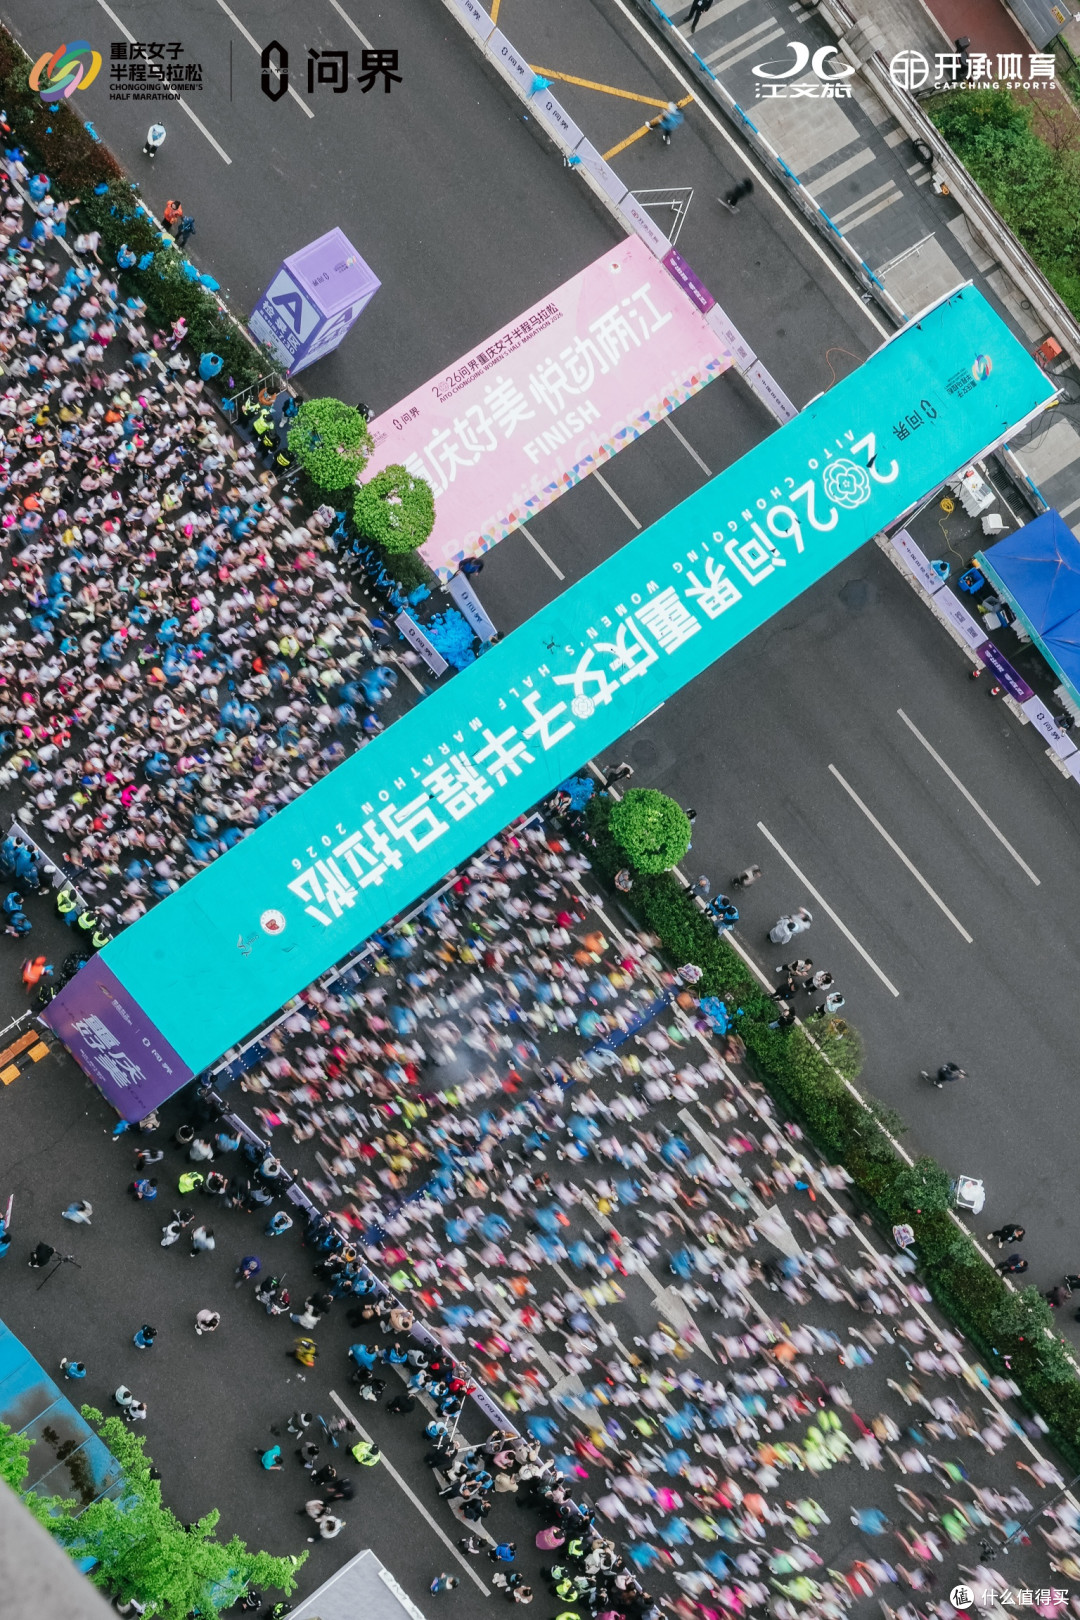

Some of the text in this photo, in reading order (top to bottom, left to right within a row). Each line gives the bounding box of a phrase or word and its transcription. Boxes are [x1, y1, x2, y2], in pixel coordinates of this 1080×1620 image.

[508, 55, 525, 76] 问界
[552, 110, 569, 131] 问界
[271, 291, 303, 335] A
[439, 312, 564, 403] AITO CHONGQING WOMEN'S HALF MARATHON 2026
[529, 281, 673, 416] 悦动两江
[400, 405, 421, 426] 问界
[892, 409, 925, 441] 问界
[523, 400, 602, 465] FINISH
[290, 429, 855, 870] AITO CHONGQING WOMEN'S HALF MARATHON 2026
[1044, 721, 1061, 742] 问界
[151, 1049, 173, 1076] 问界
